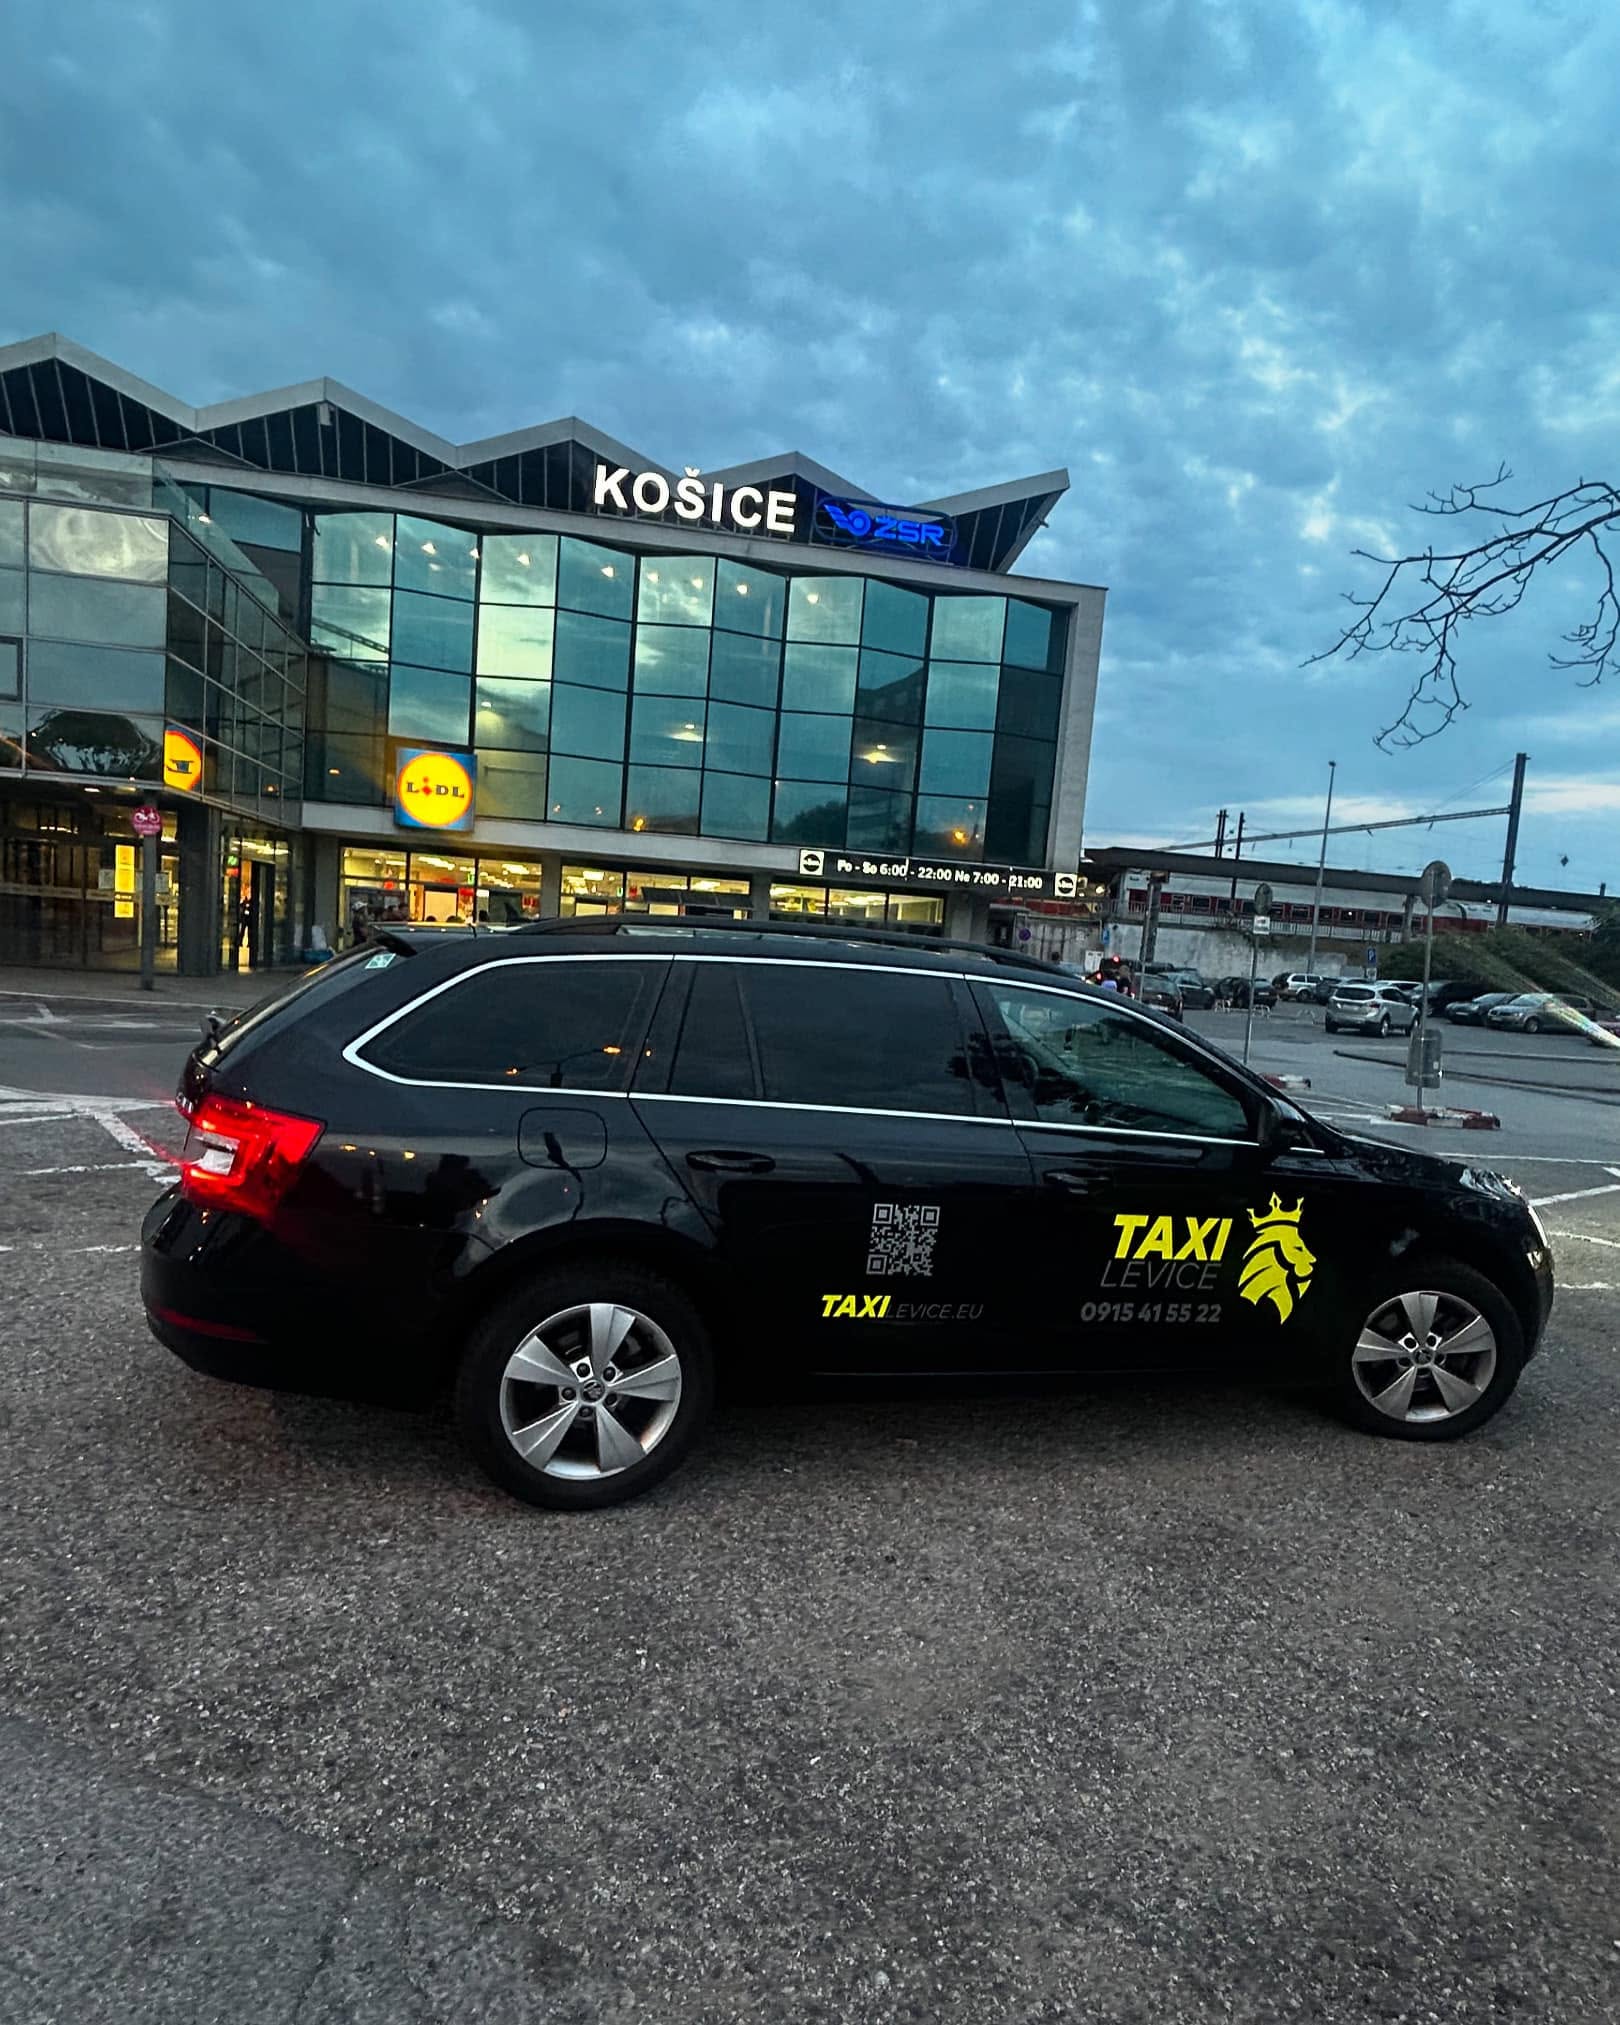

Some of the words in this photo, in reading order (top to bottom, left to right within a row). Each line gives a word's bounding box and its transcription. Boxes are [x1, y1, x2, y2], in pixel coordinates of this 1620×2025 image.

[593, 464, 797, 533] KOŠICE
[873, 515, 945, 547] ŽSR
[837, 859, 852, 872] Po
[863, 862, 877, 875] So
[880, 863, 908, 877] 6:00
[918, 867, 951, 881] 22:00
[955, 870, 970, 883] Ne
[973, 872, 1000, 885] 7:00
[1010, 875, 1043, 889] 21:00
[1113, 1214, 1234, 1261] TAXI
[1100, 1259, 1223, 1289] LEVICE
[1080, 1302, 1135, 1323] 0915
[1137, 1302, 1162, 1323] 41
[1165, 1303, 1192, 1323] 55
[1195, 1304, 1222, 1322] 22
